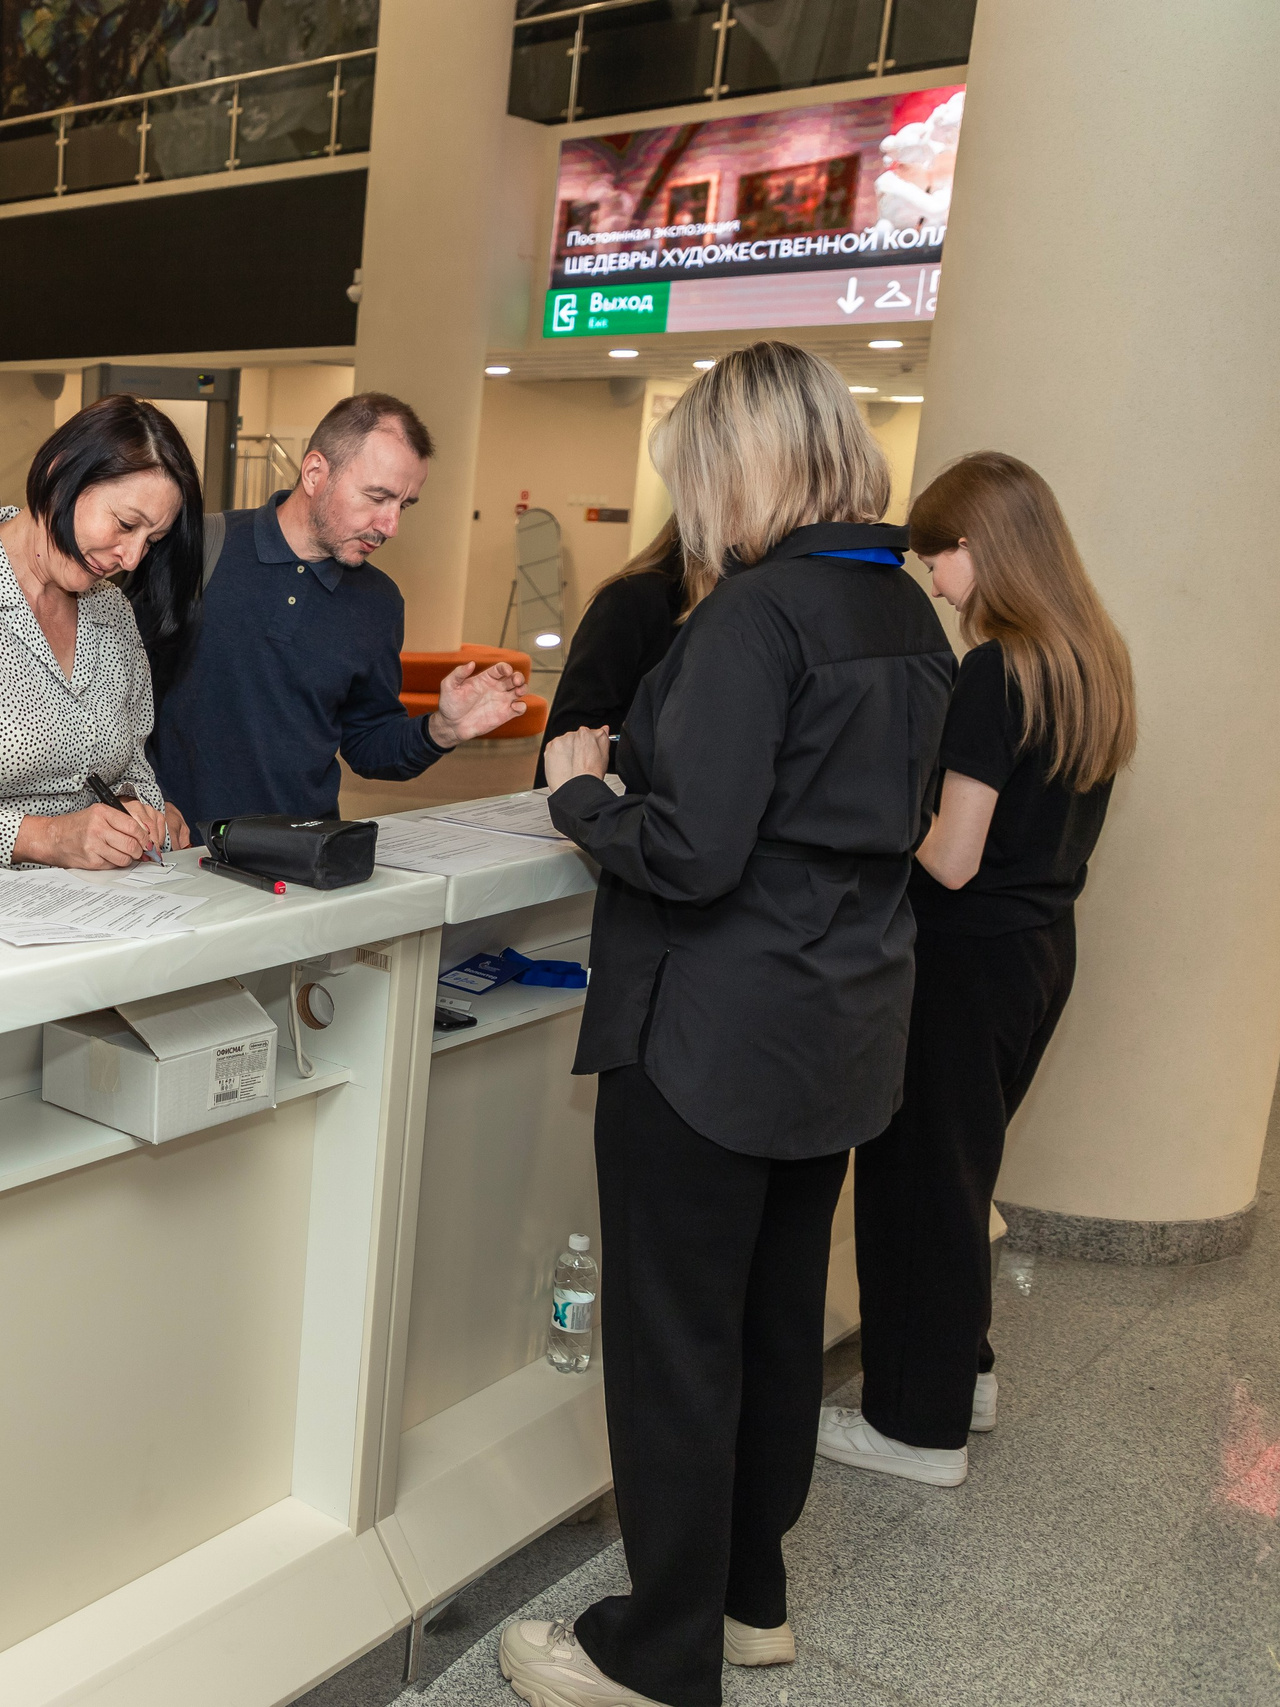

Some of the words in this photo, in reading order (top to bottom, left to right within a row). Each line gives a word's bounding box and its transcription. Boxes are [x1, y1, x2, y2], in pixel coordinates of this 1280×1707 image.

[566, 227, 651, 247] Постоянная
[653, 219, 741, 240] экспозиция
[564, 249, 657, 276] ШЕДЕВРЫ
[659, 226, 879, 269] ХУДОЖЕСТВЕННОЙ
[589, 292, 653, 313] Выход
[216, 1044, 246, 1057] ОФИСМАГ
